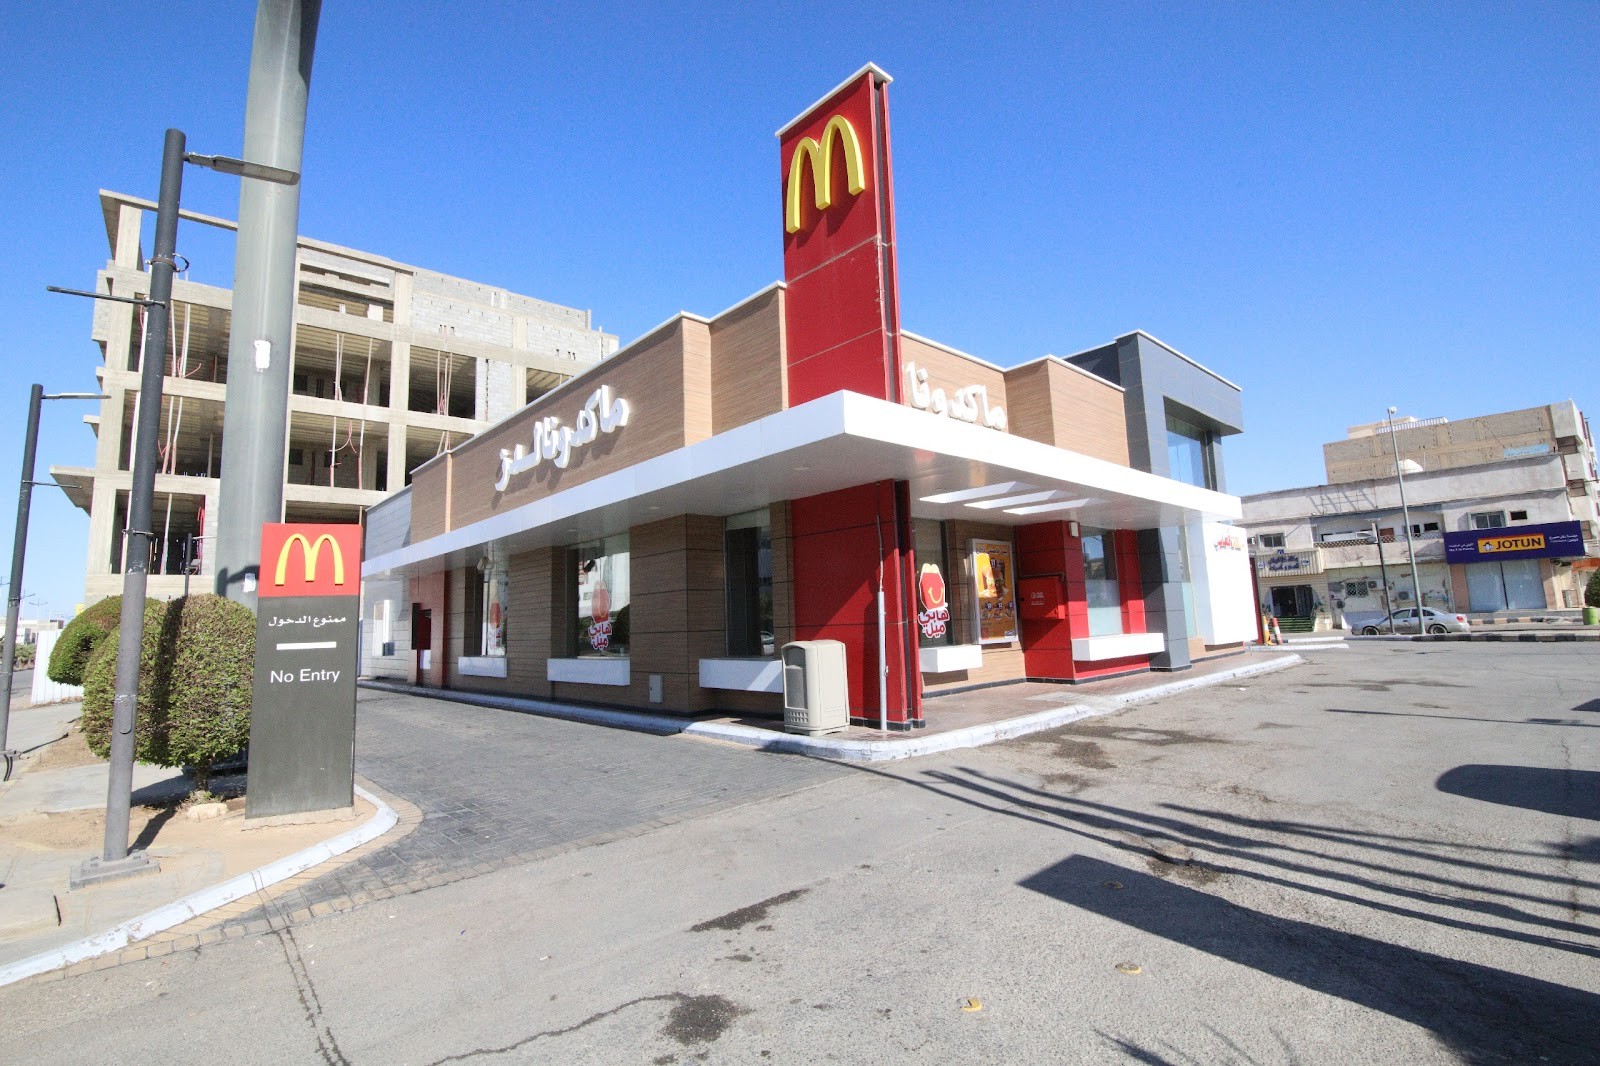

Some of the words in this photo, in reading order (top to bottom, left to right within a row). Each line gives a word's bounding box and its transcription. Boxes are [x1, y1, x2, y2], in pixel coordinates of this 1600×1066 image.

[495, 384, 630, 492] ماكدونالدز
[1496, 538, 1542, 550] JOTUN
[268, 615, 312, 627] الدخول
[313, 615, 347, 628] ممنوع
[918, 609, 950, 627] هابي
[925, 622, 946, 637] ميل
[270, 670, 294, 683] No
[300, 668, 340, 683] Entry
